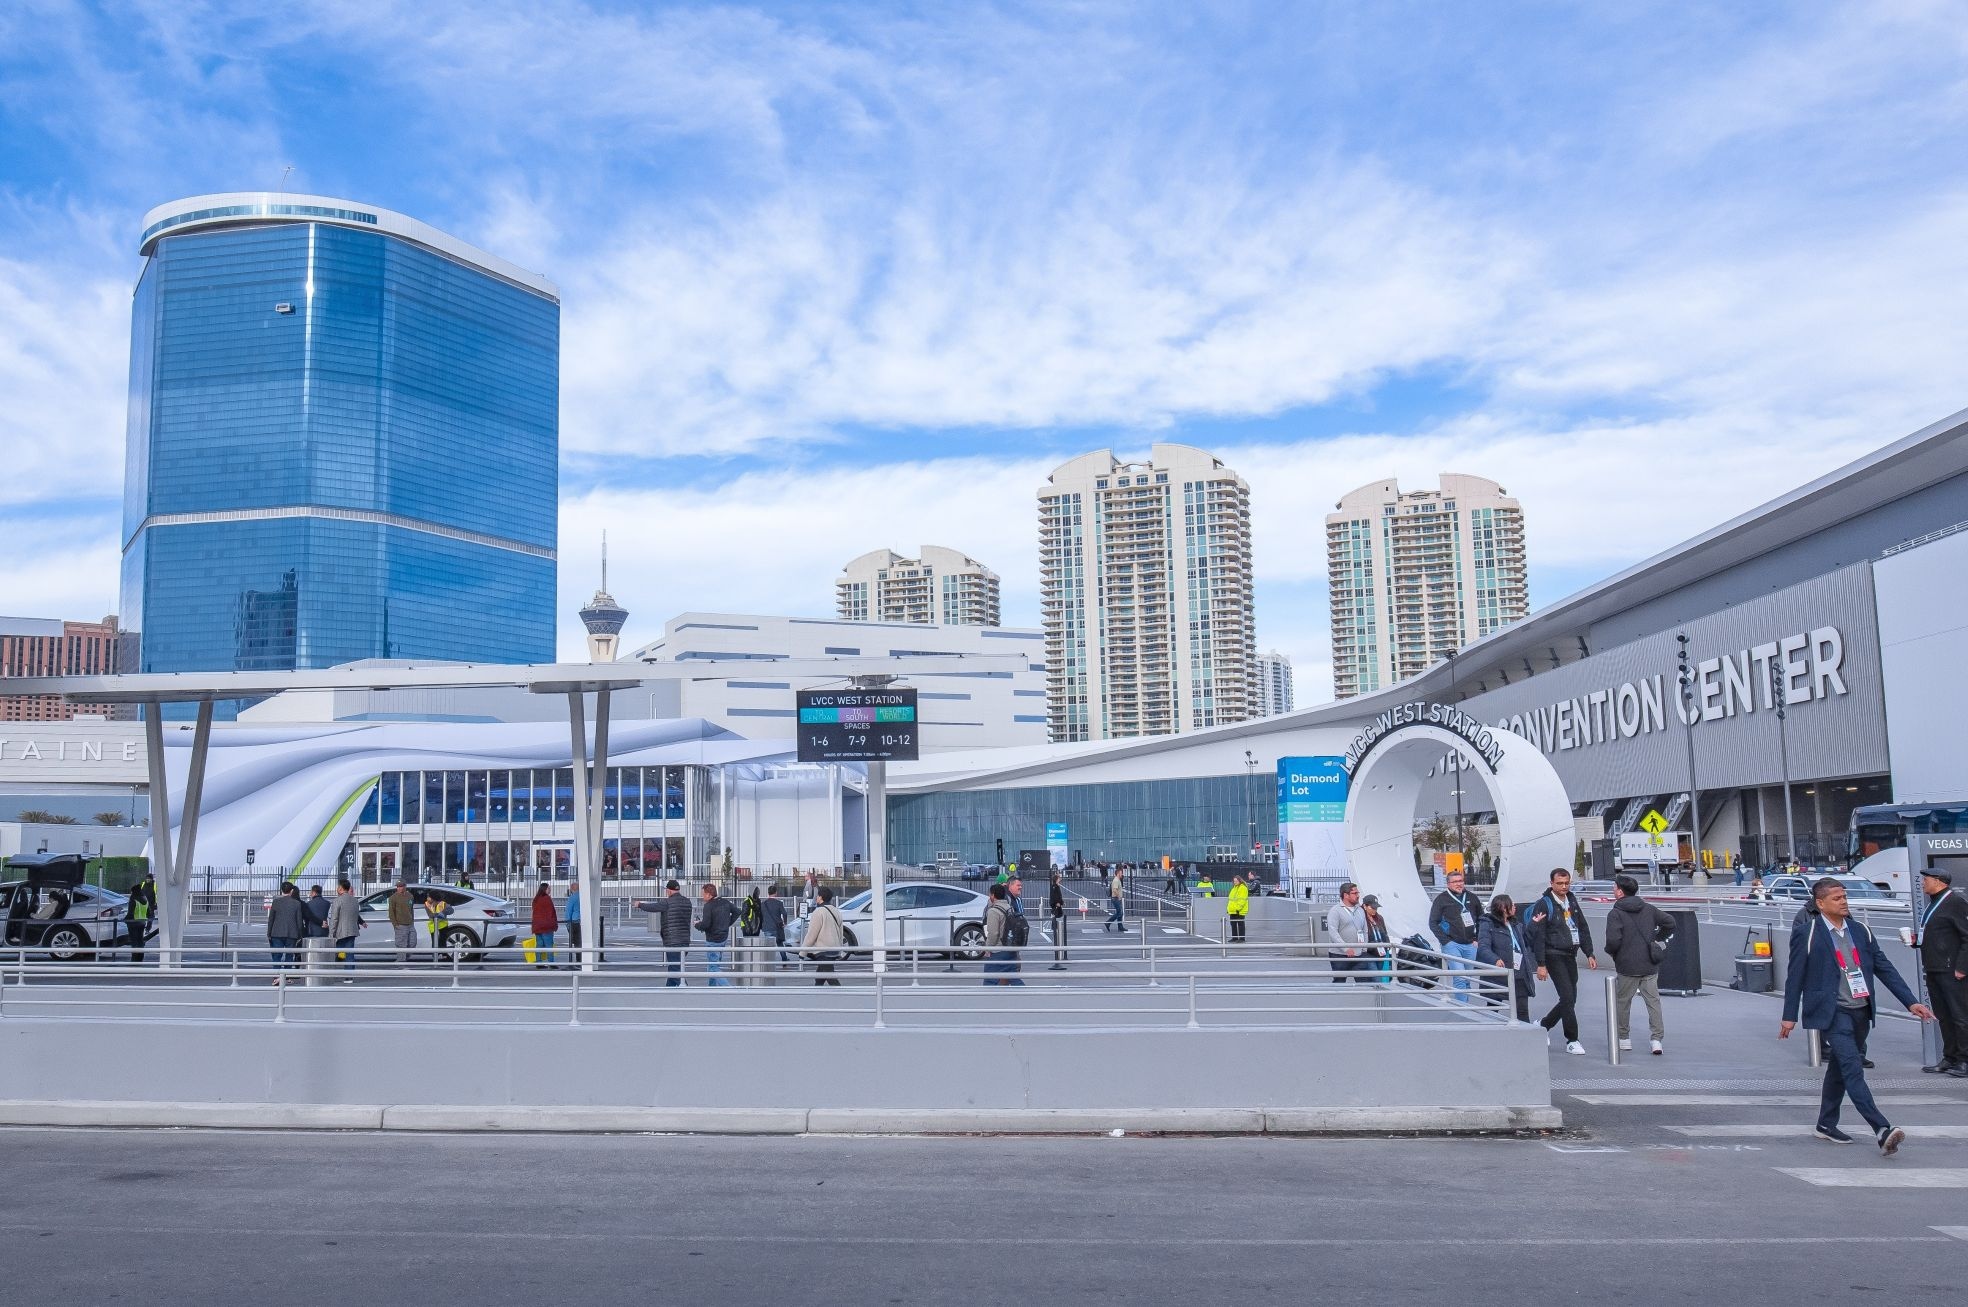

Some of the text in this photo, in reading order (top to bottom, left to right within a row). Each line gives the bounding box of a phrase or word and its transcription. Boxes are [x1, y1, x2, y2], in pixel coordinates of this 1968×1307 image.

[1498, 626, 1848, 753] ONVENTION CENTER
[811, 695, 903, 705] LVCC WEST STATION
[811, 736, 829, 746] 1-6
[849, 735, 866, 746] 7-9
[881, 734, 911, 745] 10-12
[1340, 724, 1378, 775] LVCC
[1376, 701, 1426, 733] WEST
[1430, 703, 1505, 767] STATION
[1291, 773, 1340, 783] Diamond
[1291, 786, 1310, 795] Lot
[1927, 839, 1963, 849] VEGAS
[346, 854, 354, 863] 12
